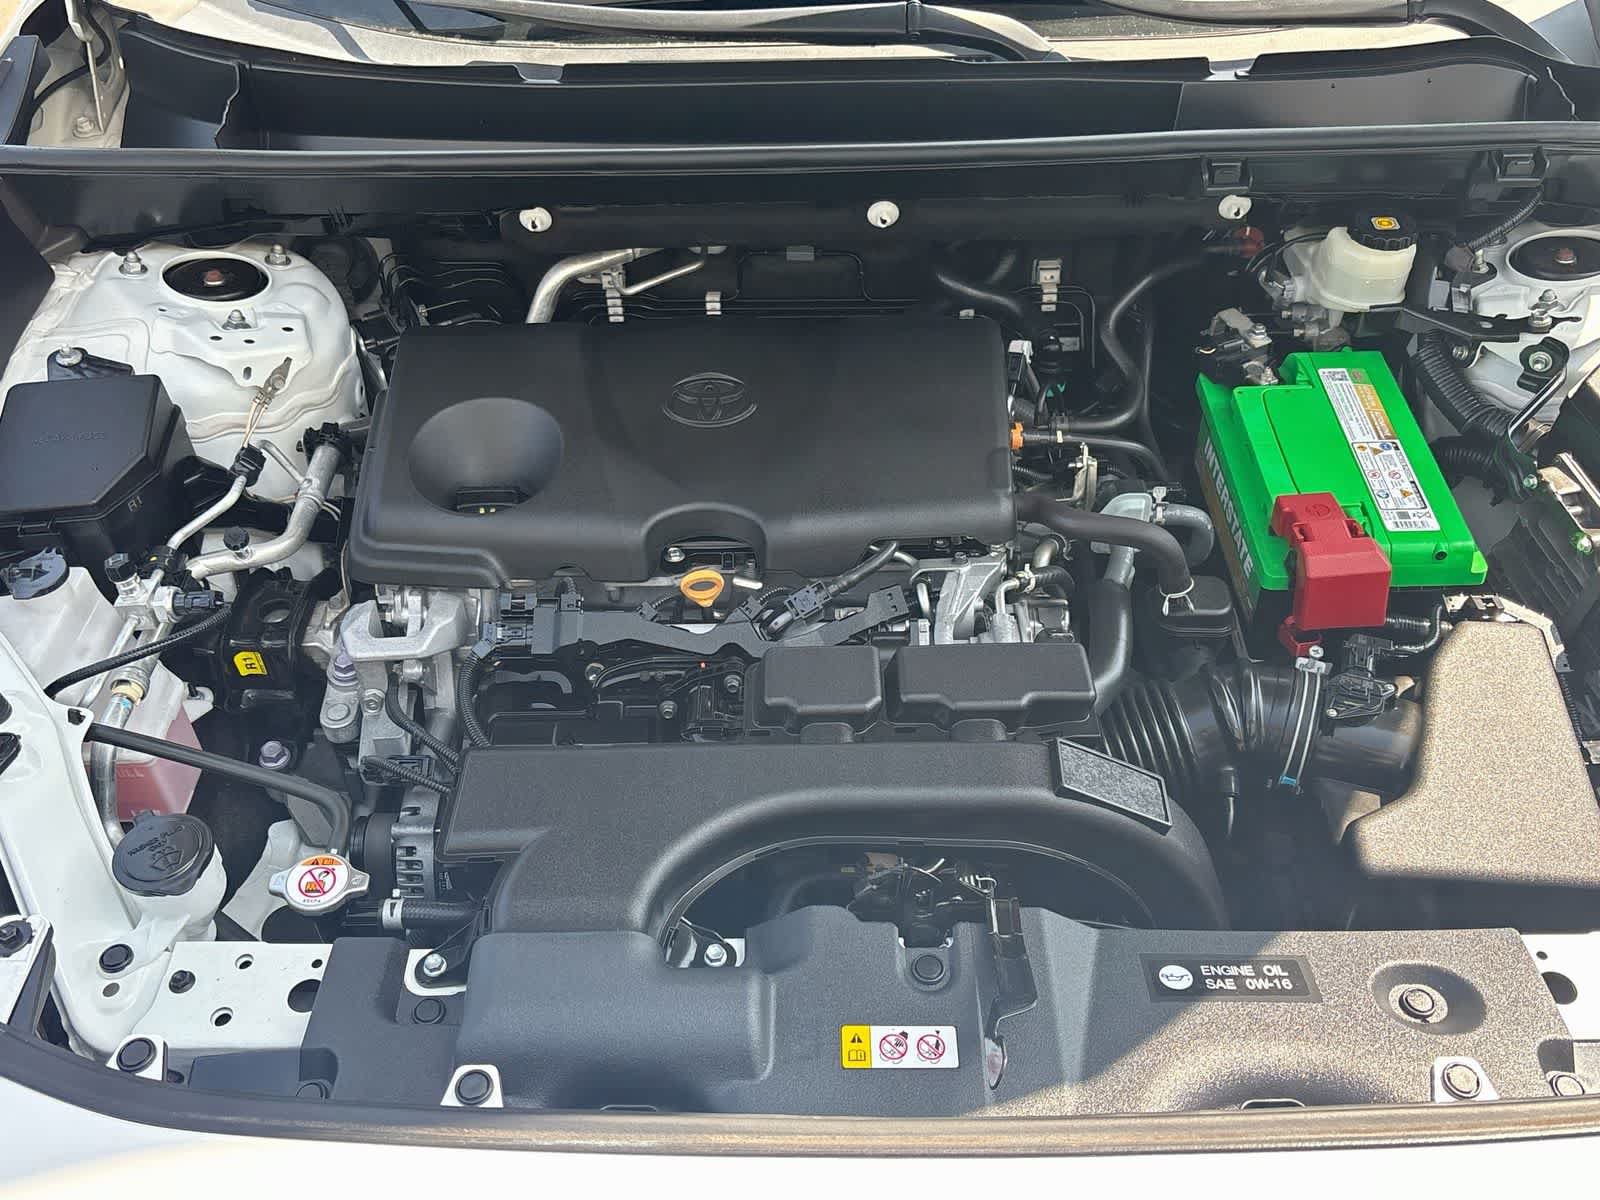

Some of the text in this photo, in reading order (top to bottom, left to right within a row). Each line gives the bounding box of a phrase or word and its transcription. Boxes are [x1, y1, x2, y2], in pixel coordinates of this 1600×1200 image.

[127, 495, 143, 512] R1
[1204, 436, 1254, 579] INTERSTATE
[1200, 965, 1288, 977] ENGINE OIL
[1206, 978, 1293, 990] SAE 0W-16
